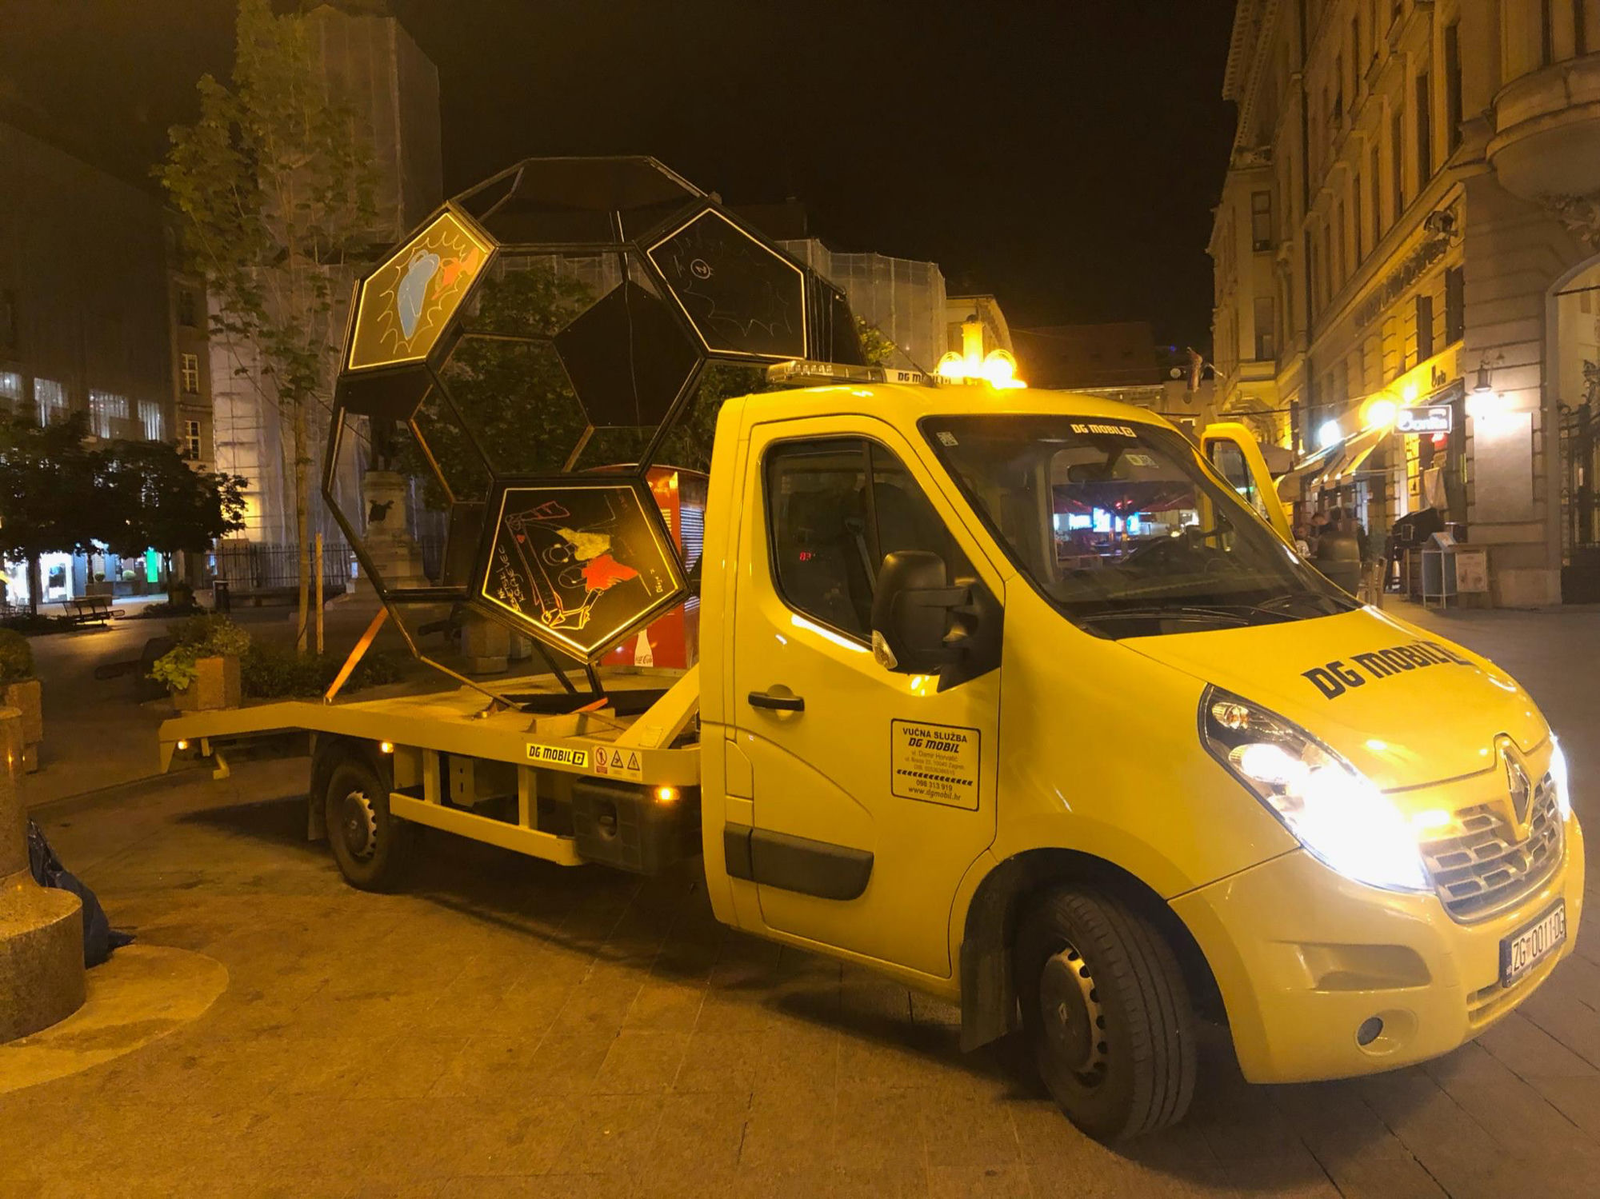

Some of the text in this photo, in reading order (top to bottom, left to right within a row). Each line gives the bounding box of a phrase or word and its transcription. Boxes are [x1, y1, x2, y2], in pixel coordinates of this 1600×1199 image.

[898, 372, 910, 382] DG
[1070, 423, 1124, 435] DG MOBIL
[1301, 642, 1449, 700] DG MOBIL
[903, 728, 967, 742] VUČNA SLUŽBA
[909, 738, 959, 753] DG MOBIL
[529, 745, 572, 763] DG MOBIL
[1513, 938, 1526, 971] ZG
